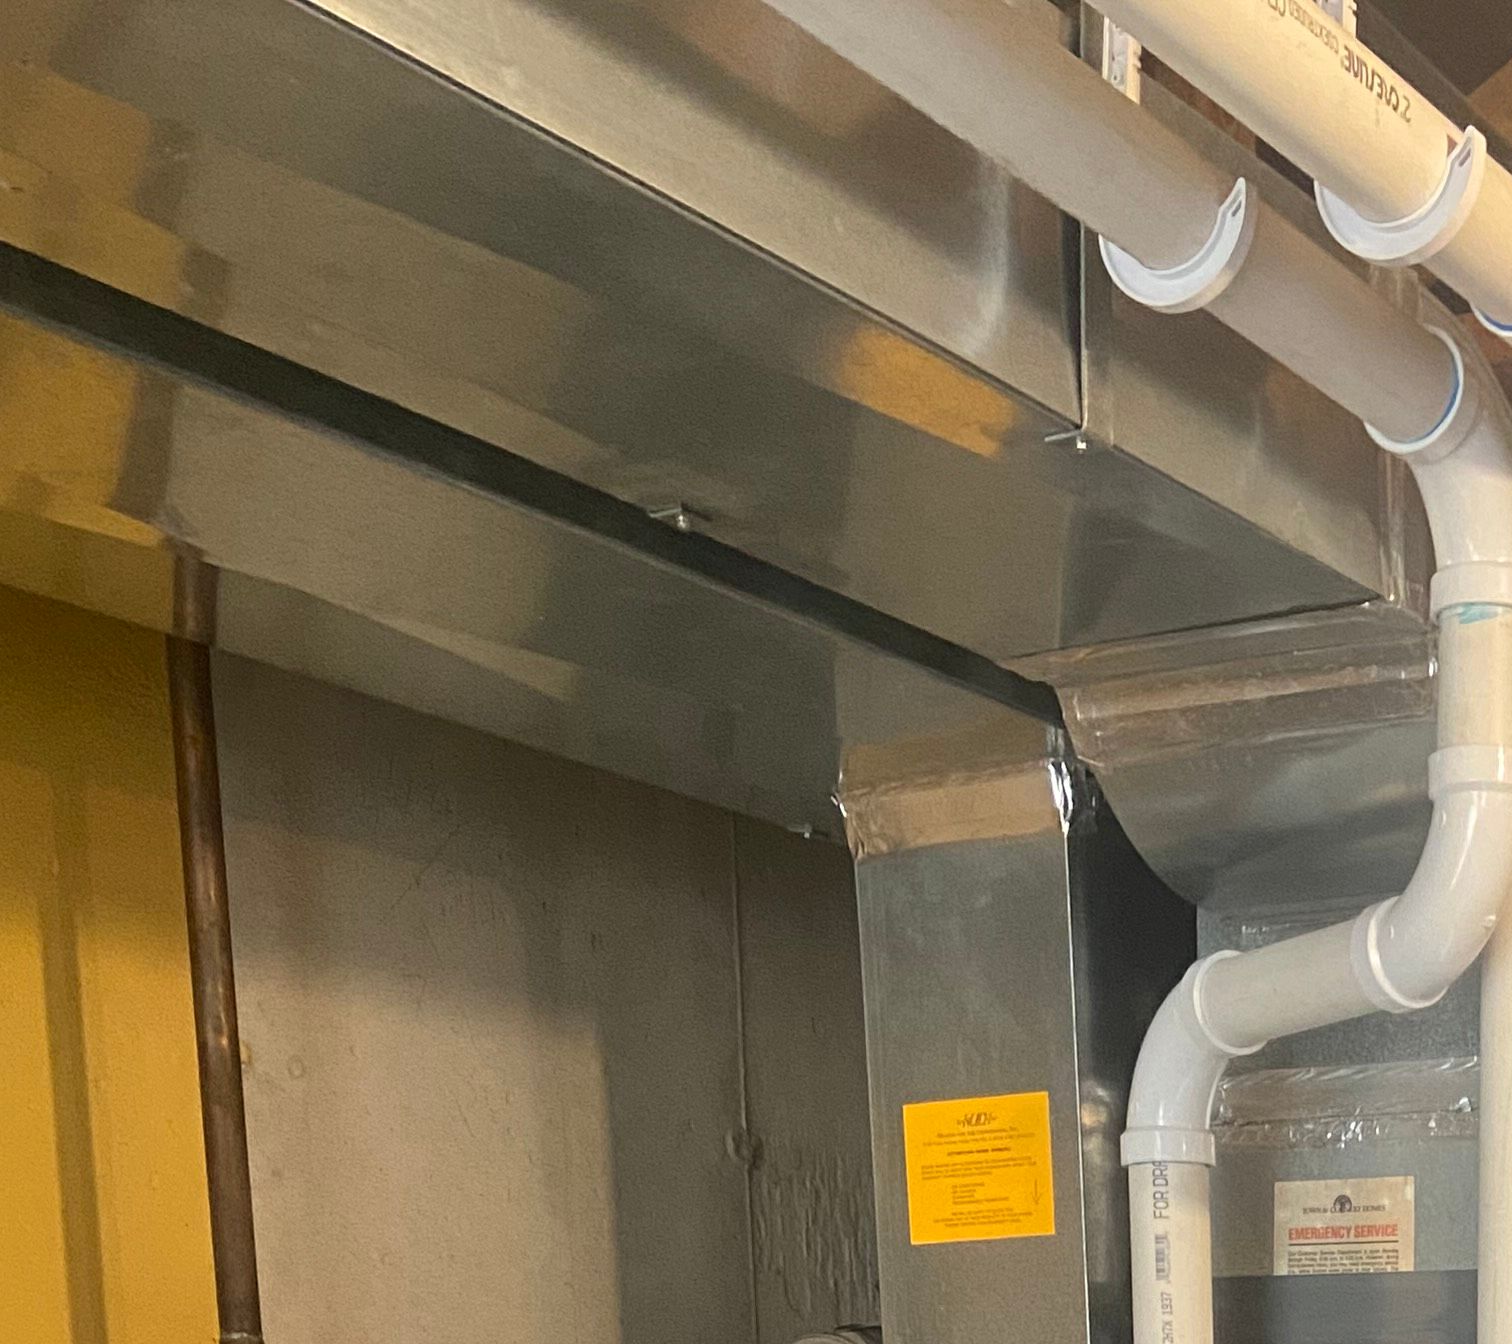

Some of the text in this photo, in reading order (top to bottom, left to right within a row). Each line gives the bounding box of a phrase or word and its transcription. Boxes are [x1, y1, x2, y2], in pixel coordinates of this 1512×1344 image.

[1153, 1191, 1170, 1219] FOR
[1288, 1223, 1398, 1241] EMERGENCY SERVICE
[1160, 1292, 1173, 1316] 1937
